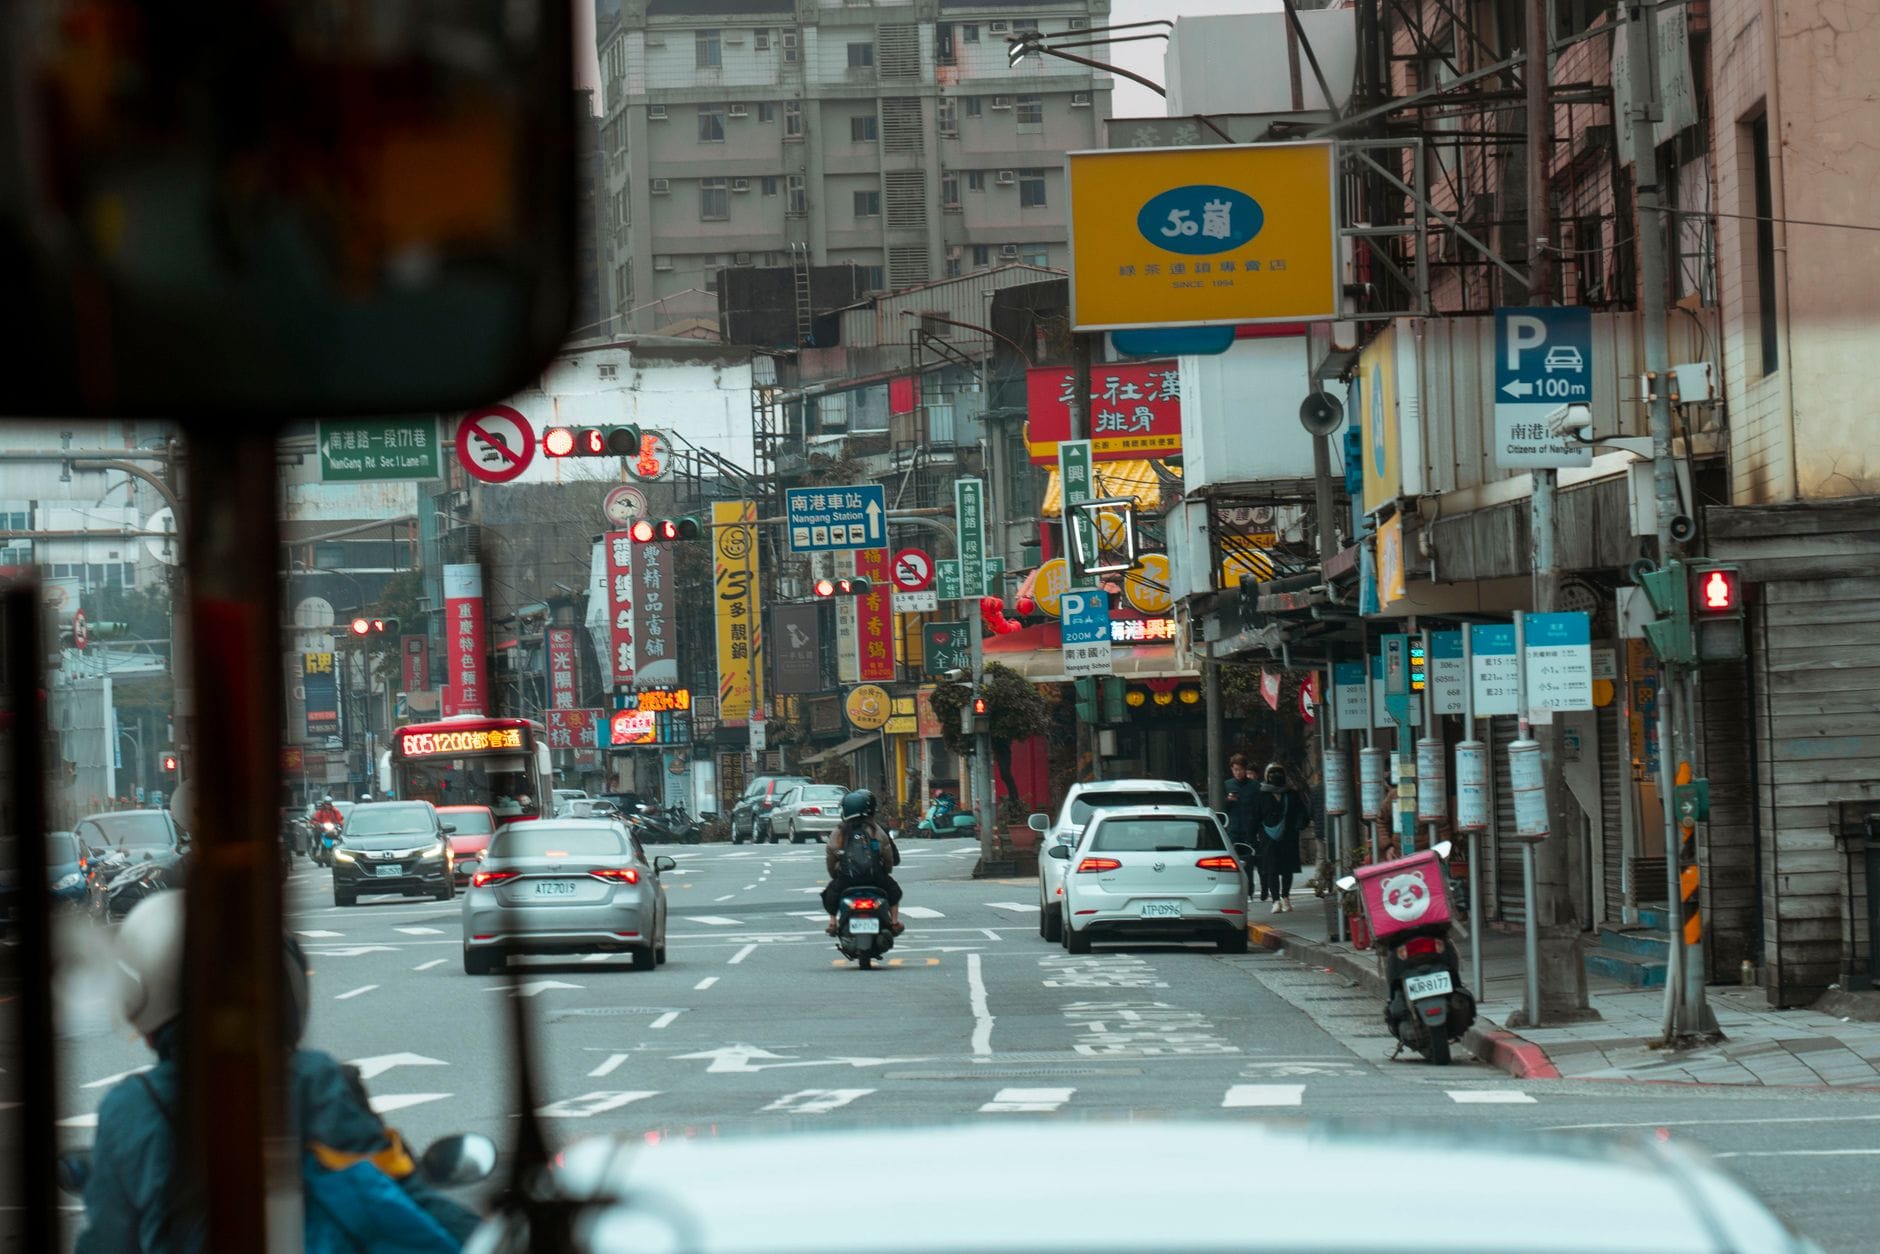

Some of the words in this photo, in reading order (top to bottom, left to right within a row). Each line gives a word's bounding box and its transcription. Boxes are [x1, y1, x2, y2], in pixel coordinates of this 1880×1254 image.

[1172, 280, 1204, 289] SINCE
[1506, 315, 1548, 371] P
[1535, 378, 1586, 397] 100m
[1095, 405, 1155, 433] 排骨
[1506, 444, 1537, 454] Citizens
[1539, 443, 1547, 454] of
[1549, 444, 1583, 455] Nangang
[790, 492, 863, 512] 南港車站
[792, 514, 831, 524] Nangang
[832, 511, 864, 521] Station
[1061, 594, 1085, 626] P
[1065, 647, 1110, 660] 南港國小
